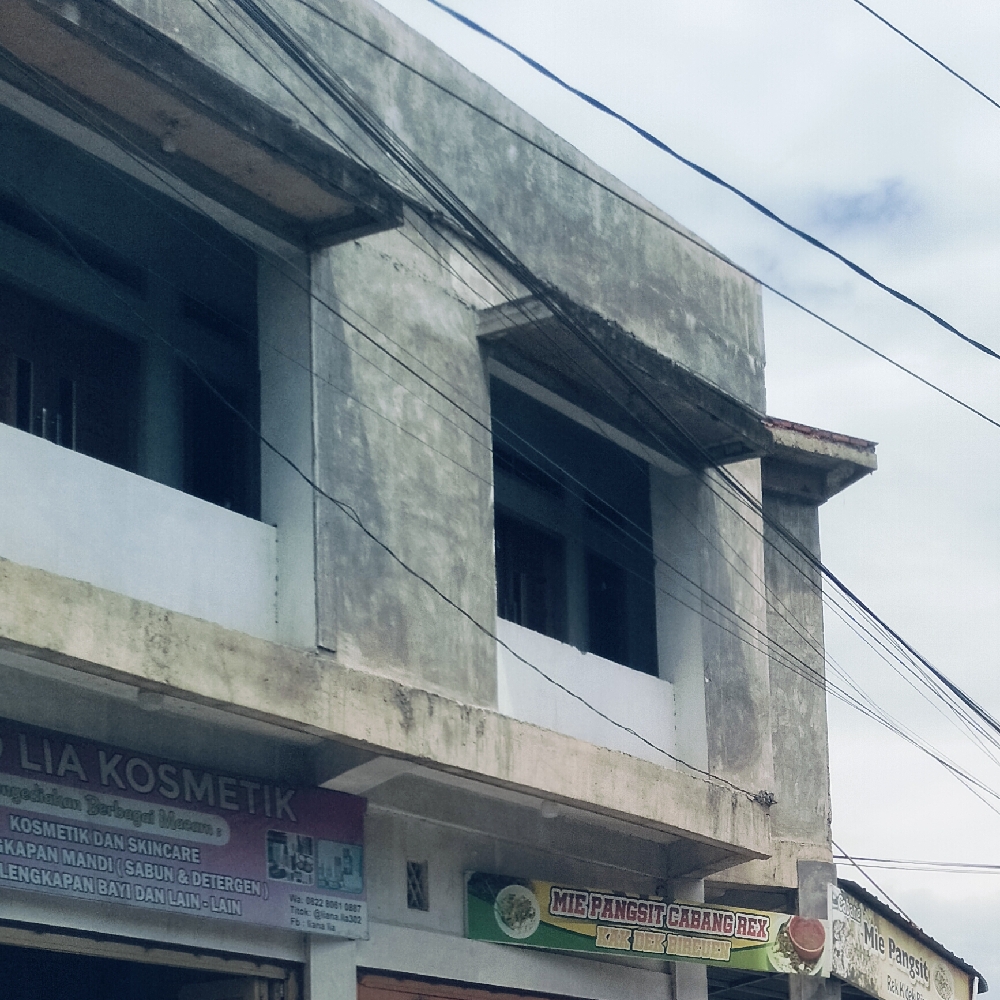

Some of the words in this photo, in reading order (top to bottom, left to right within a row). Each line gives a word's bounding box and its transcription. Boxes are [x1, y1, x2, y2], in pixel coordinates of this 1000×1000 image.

[19, 733, 88, 781] LIA
[98, 750, 297, 822] KOSMETIK
[9, 814, 90, 845] KOSMETIK
[92, 830, 125, 851] DAN
[128, 836, 201, 864] SKINCARE
[61, 848, 113, 873] MANDI
[125, 859, 175, 883] SABUN
[178, 869, 189, 885] &
[191, 870, 261, 897] DETERGEN
[97, 878, 132, 900] BAYI
[135, 884, 166, 904] DAN
[167, 889, 201, 910] LAIN
[210, 896, 242, 917] LAIN
[551, 889, 588, 917] MIE
[590, 894, 666, 926] PANGSIT
[667, 905, 734, 935] CABANG
[735, 913, 769, 941] REX
[863, 921, 885, 953] Mie
[888, 937, 928, 981] Pangsit
